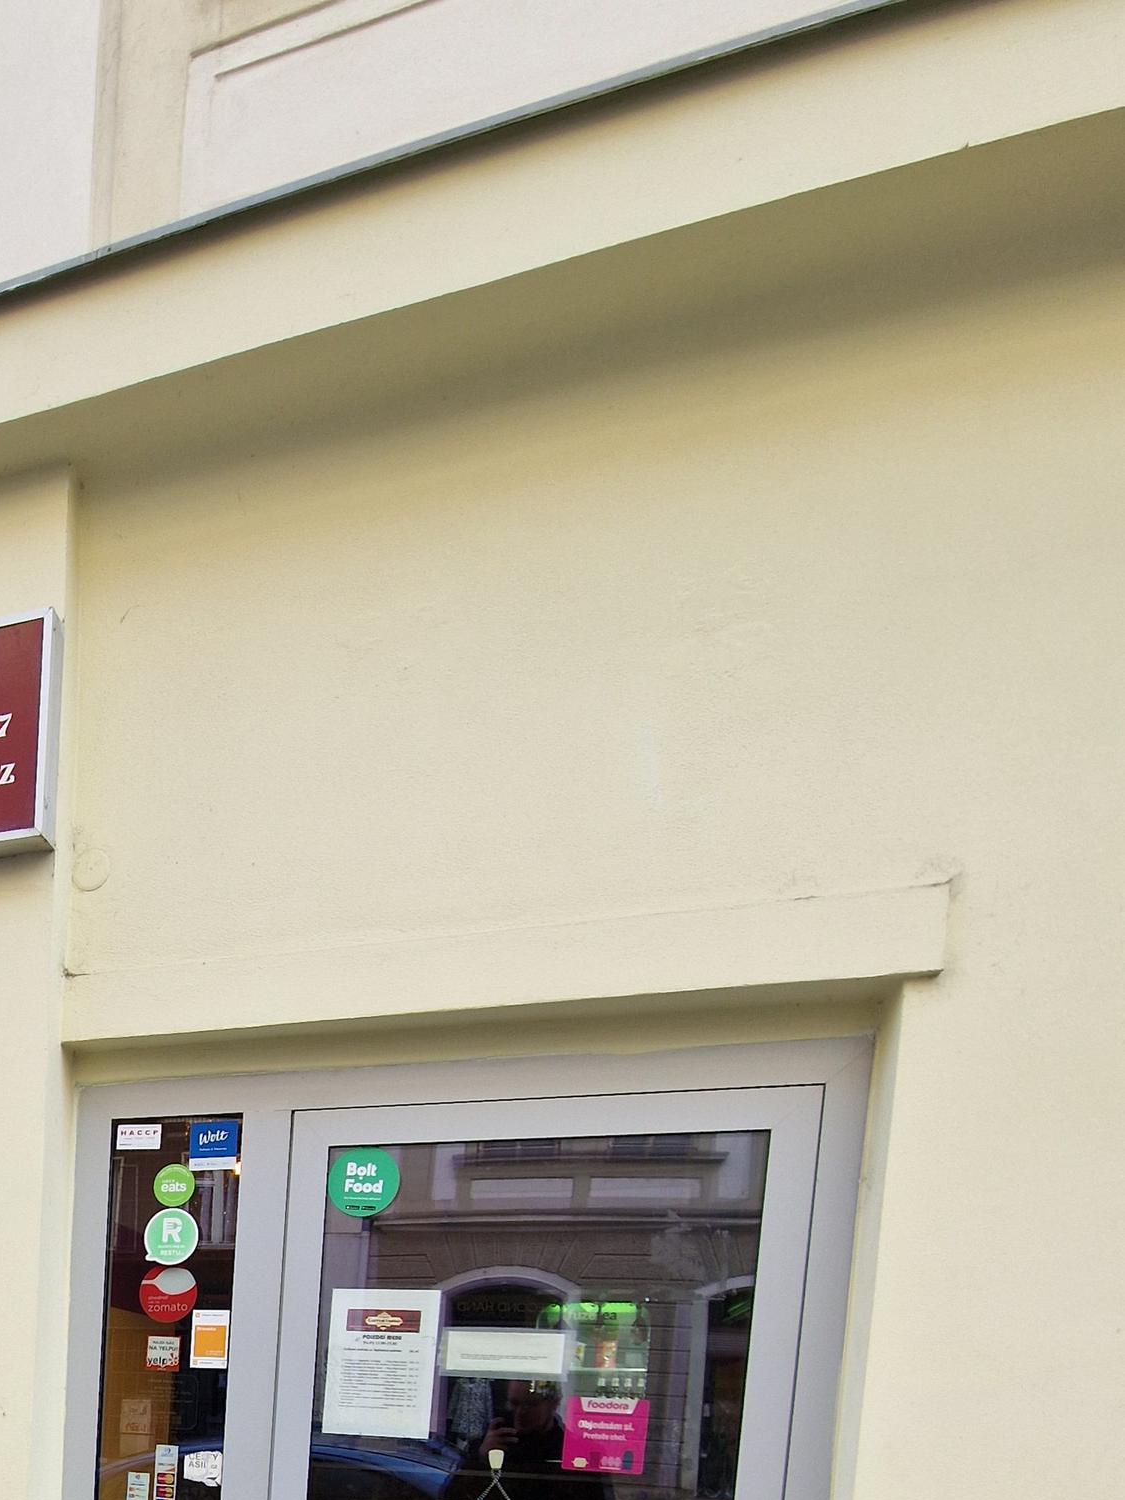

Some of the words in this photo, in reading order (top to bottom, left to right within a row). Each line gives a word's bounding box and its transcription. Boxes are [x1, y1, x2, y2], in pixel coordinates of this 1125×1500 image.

[120, 1129, 159, 1137] HACCP
[198, 1129, 230, 1146] Wolt
[346, 1161, 377, 1178] Bolt
[160, 1181, 187, 1192] eats
[344, 1178, 384, 1194] Food
[147, 1302, 188, 1312] zomato
[147, 1356, 168, 1366] yelp
[587, 1400, 630, 1410] foodora
